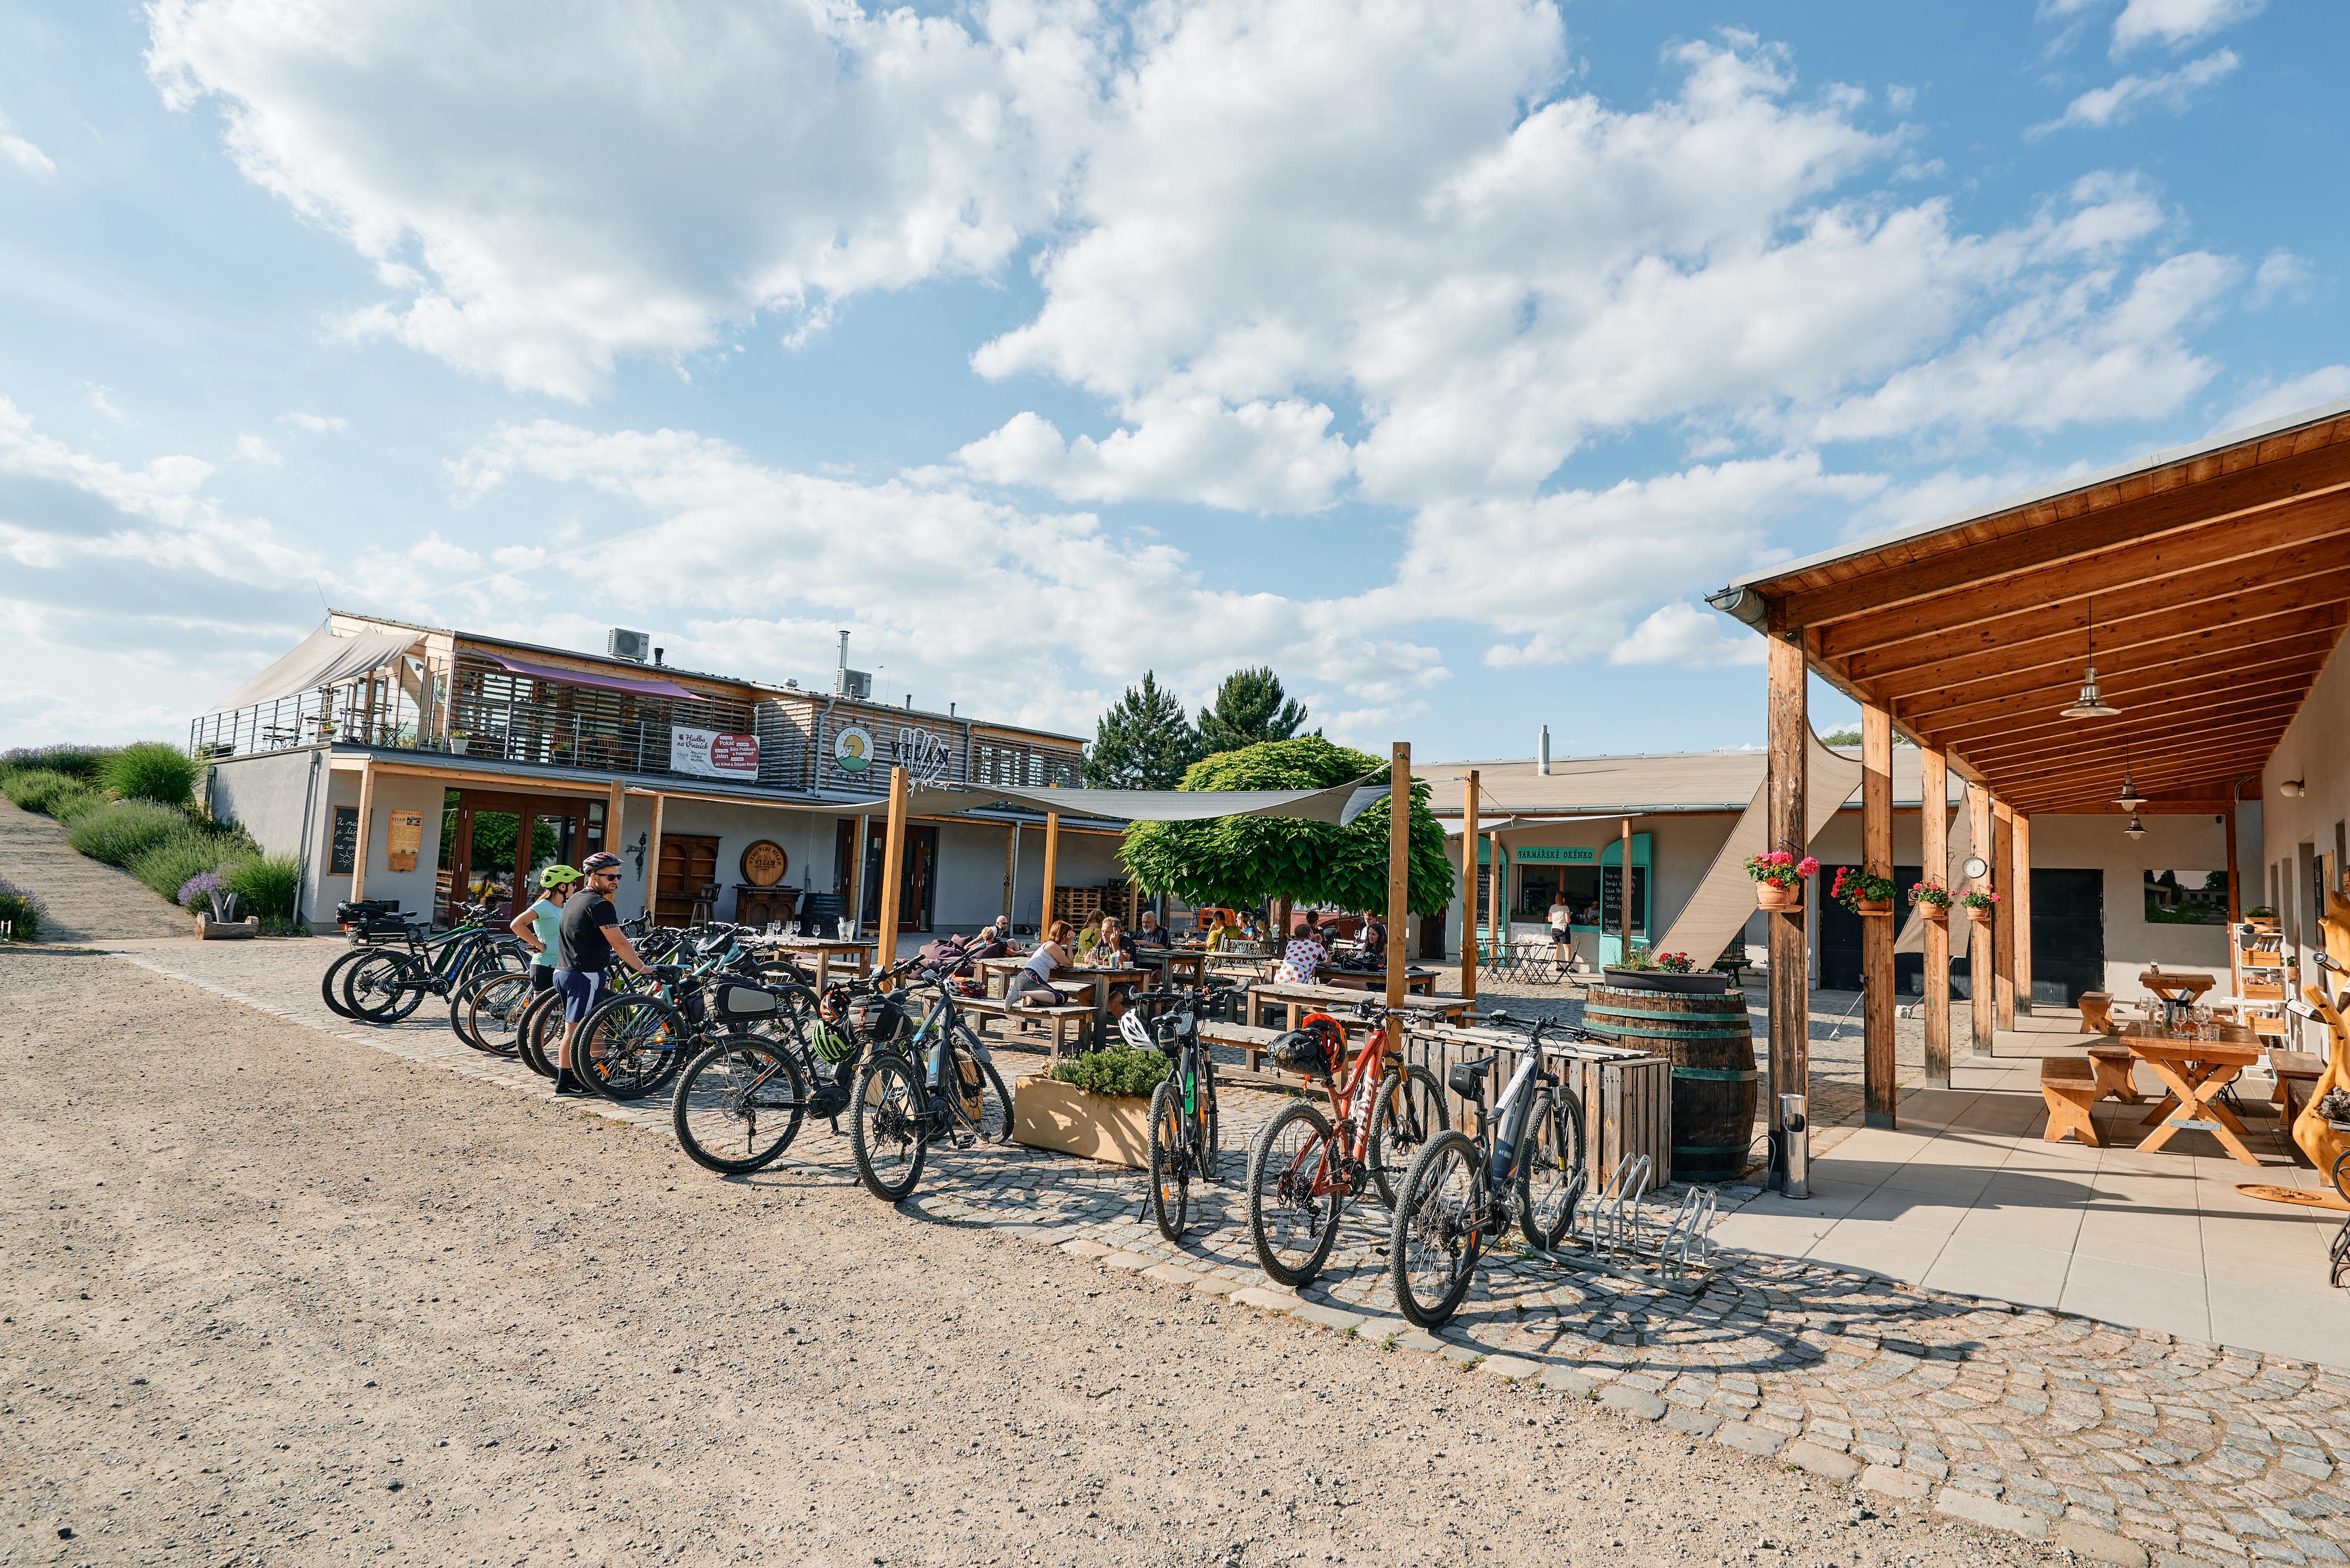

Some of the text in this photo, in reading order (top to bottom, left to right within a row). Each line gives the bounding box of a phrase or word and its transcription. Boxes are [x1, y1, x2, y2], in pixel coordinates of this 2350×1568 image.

[686, 741, 708, 750] Vinicích
[337, 817, 358, 827] U ná
[335, 828, 343, 837] je
[1518, 848, 1592, 859] FARMÁŘSKÉ OKÉNKO
[454, 946, 469, 973] GIANT
